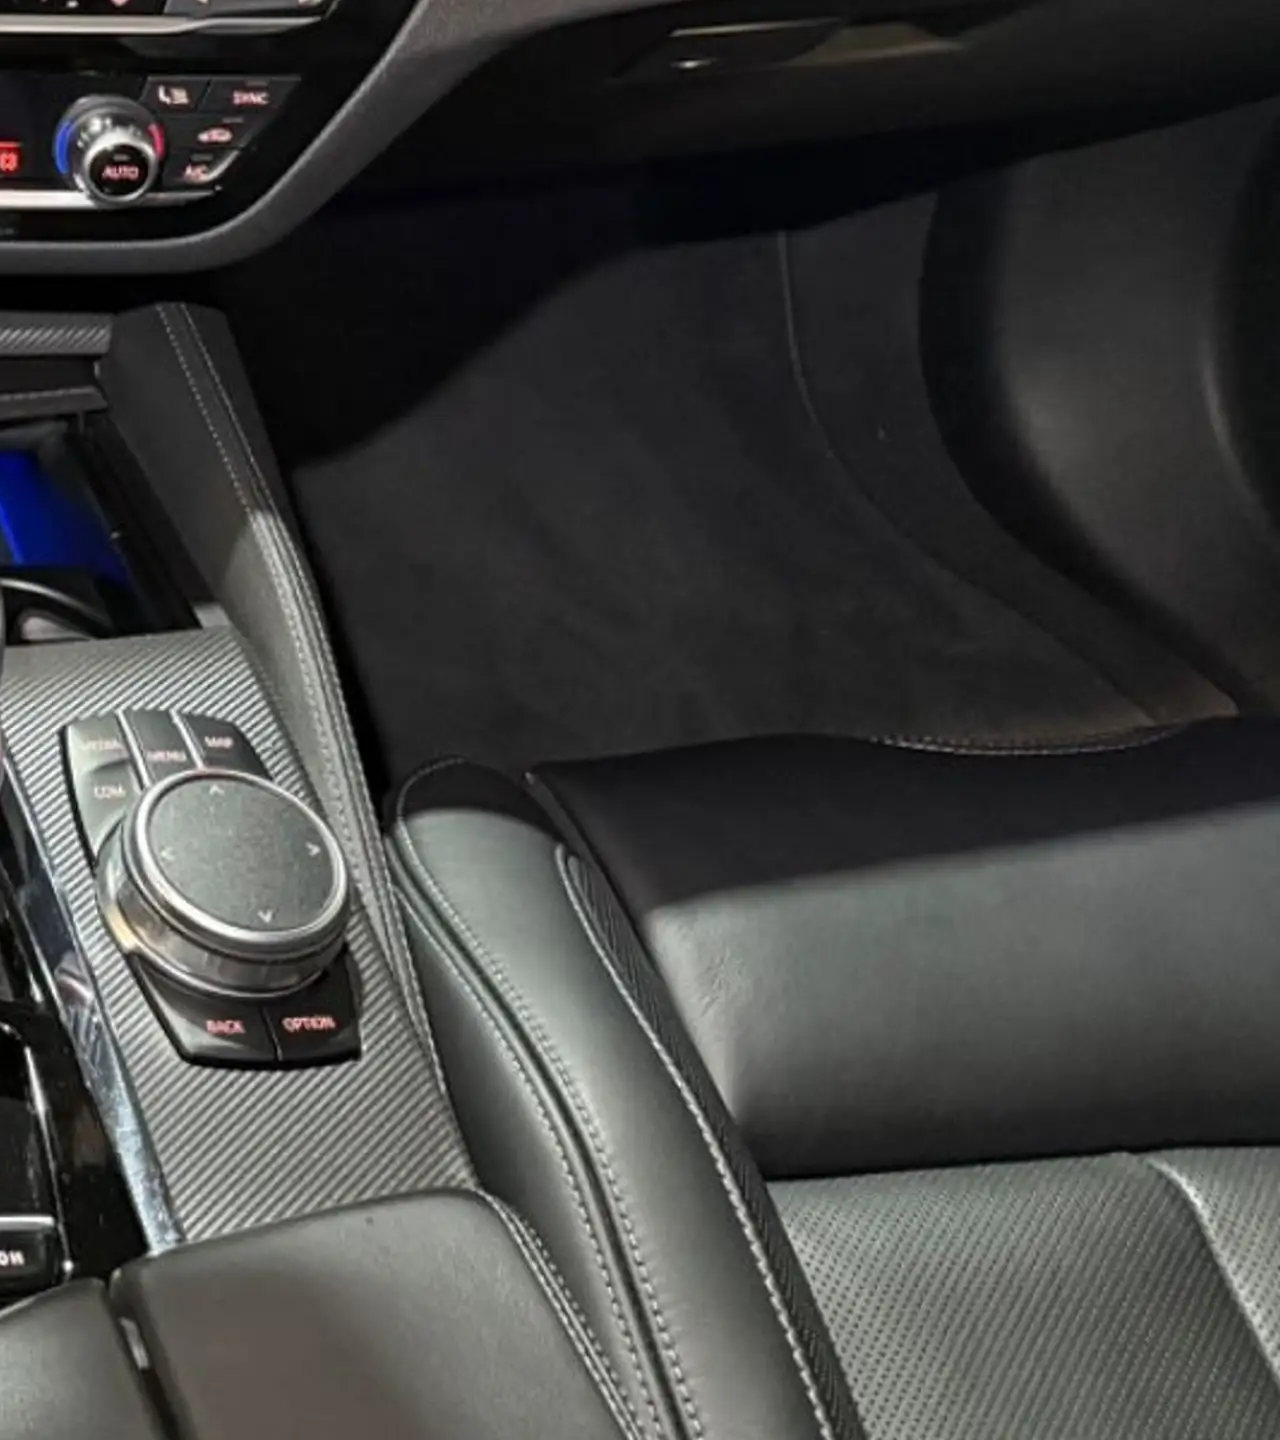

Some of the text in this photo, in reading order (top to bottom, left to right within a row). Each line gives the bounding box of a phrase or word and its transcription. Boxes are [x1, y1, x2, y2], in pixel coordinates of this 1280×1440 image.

[102, 163, 140, 180] AUTO
[205, 1019, 246, 1035] BACK
[281, 1015, 336, 1033] OPTION
